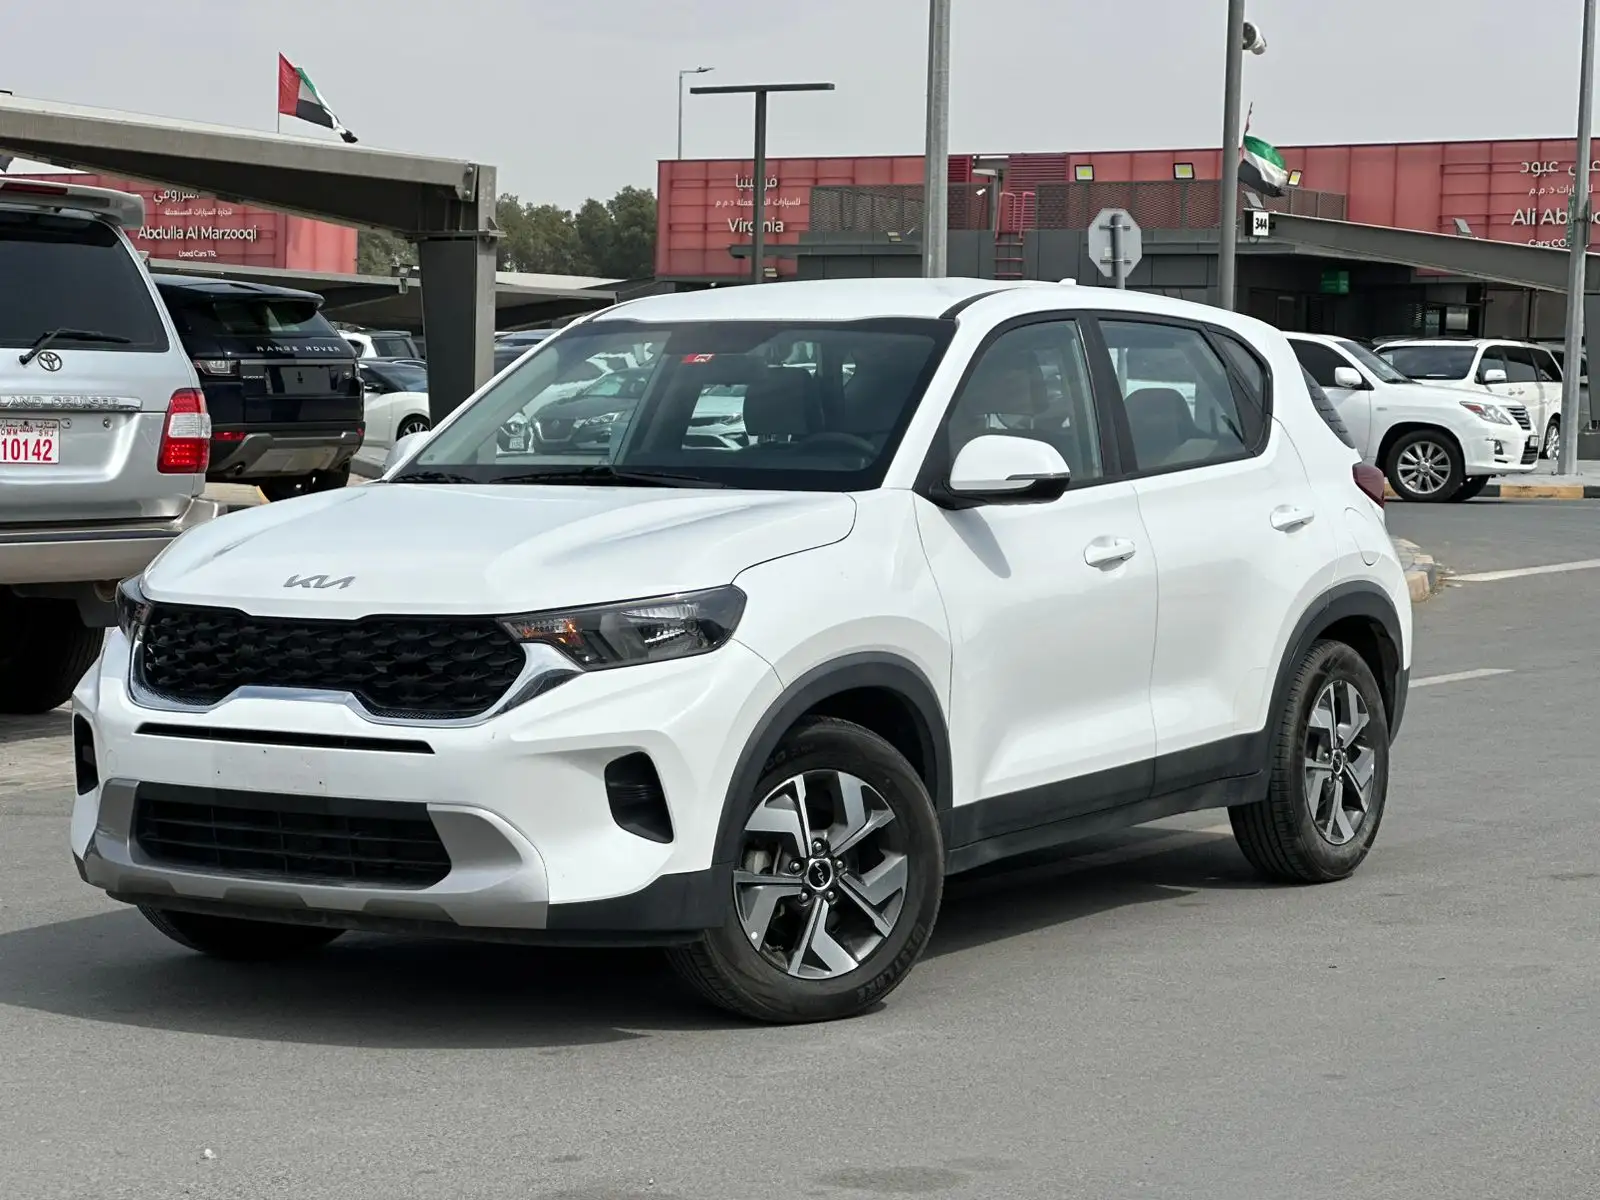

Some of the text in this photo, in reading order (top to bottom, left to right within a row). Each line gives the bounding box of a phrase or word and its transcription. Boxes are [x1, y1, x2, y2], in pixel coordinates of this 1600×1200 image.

[735, 173, 778, 191] فرينيا
[1255, 217, 1268, 230] 344
[1511, 208, 1537, 226] Ali
[138, 224, 257, 242] Abdulla Al Marzooqi
[728, 217, 784, 236] Virgnia
[0, 396, 45, 409] AND
[1, 438, 53, 461] 10142
